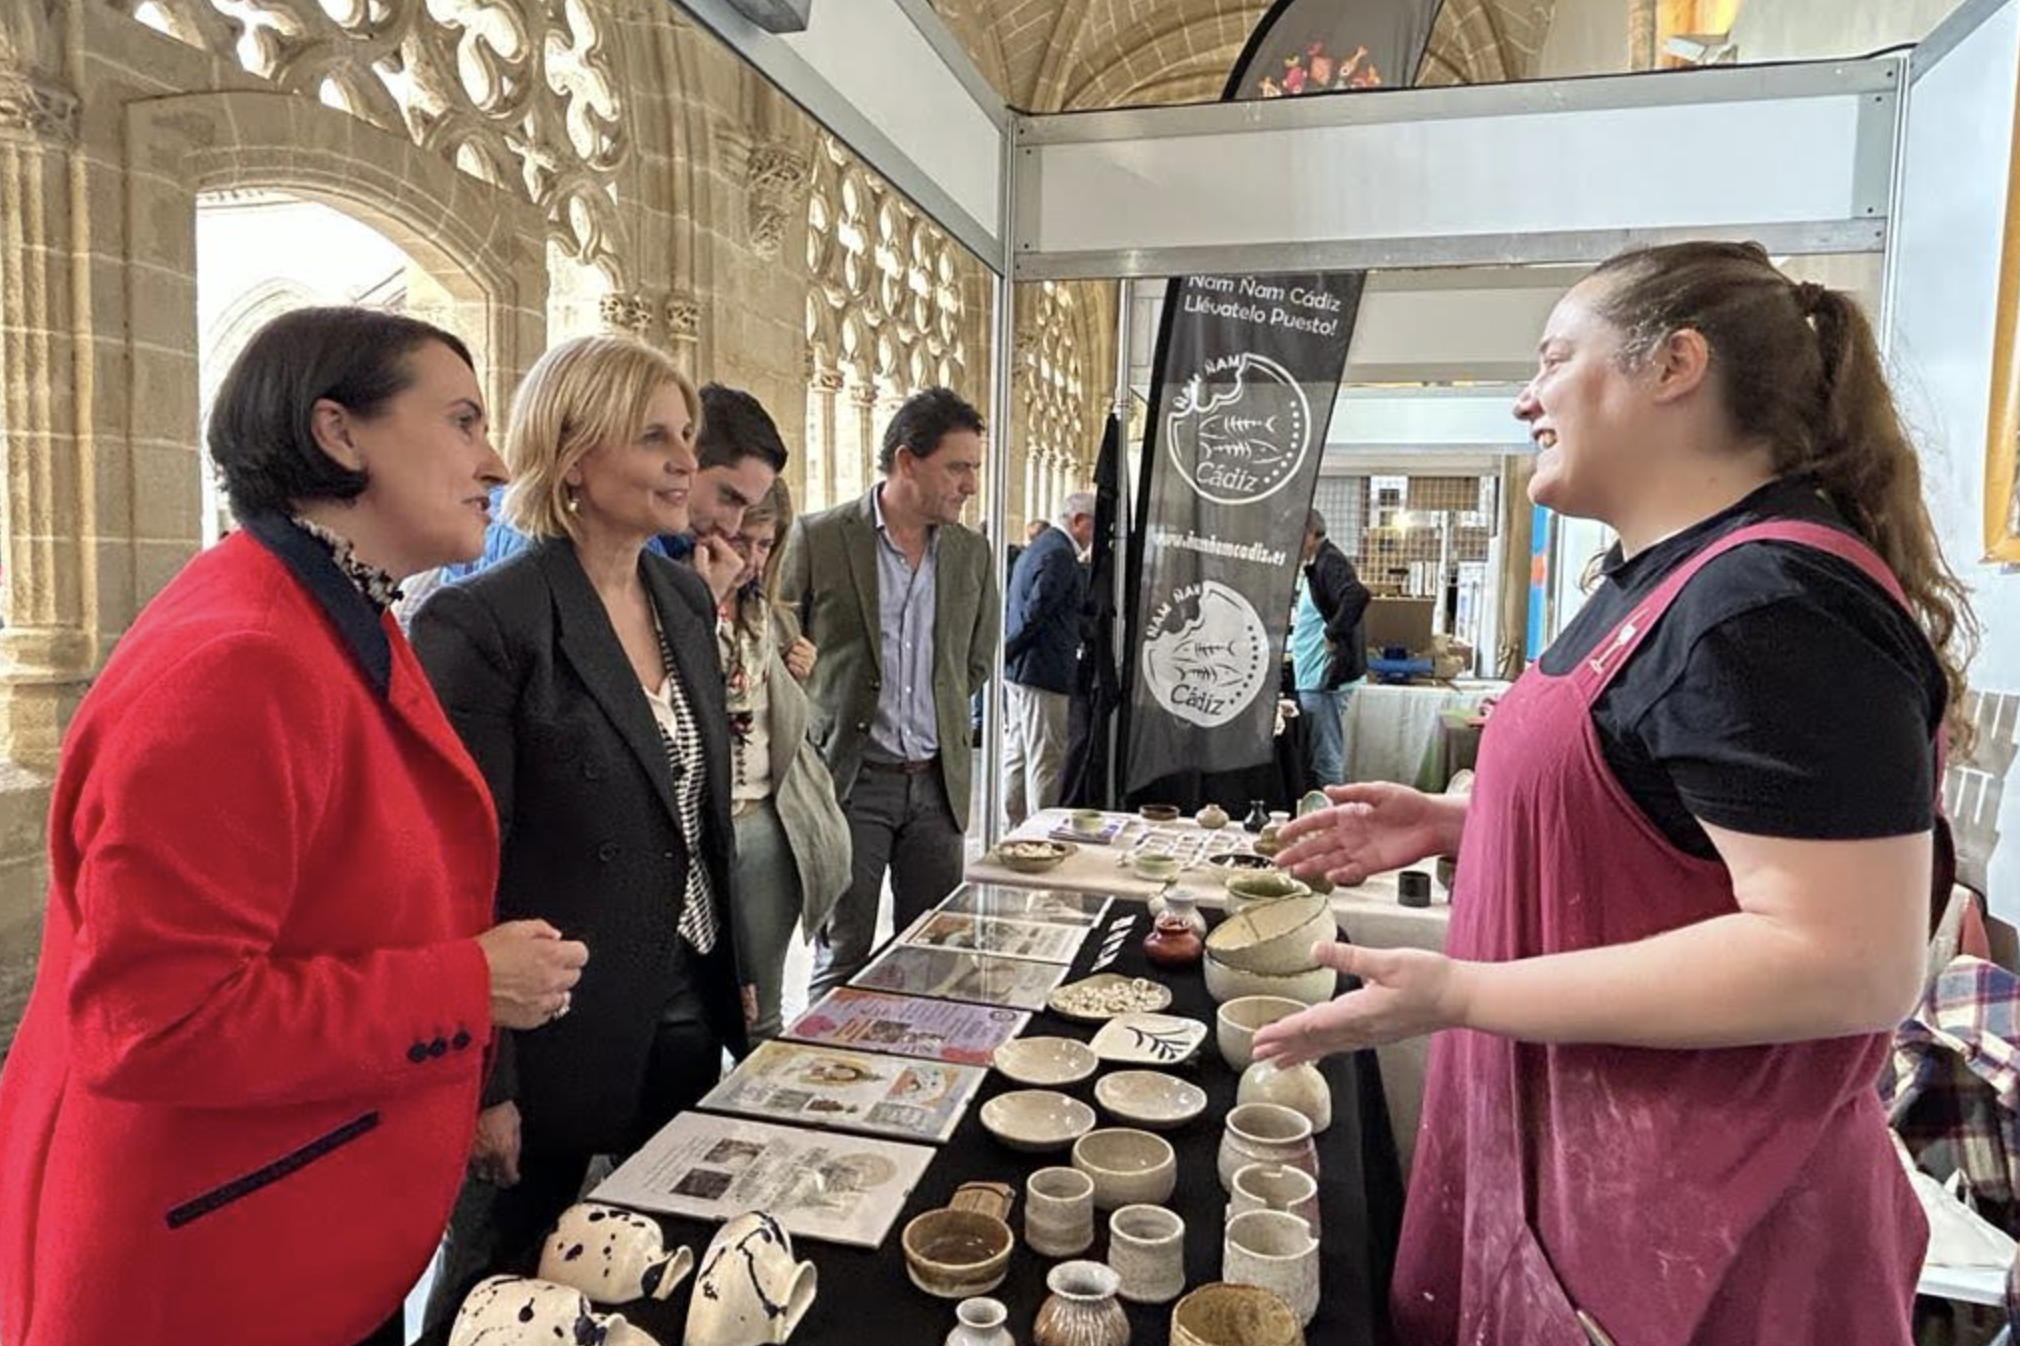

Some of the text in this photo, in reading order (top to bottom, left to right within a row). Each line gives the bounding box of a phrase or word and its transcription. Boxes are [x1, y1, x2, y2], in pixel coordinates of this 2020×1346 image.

[1238, 276, 1285, 300] Ñam
[1290, 287, 1342, 312] Cádiz
[1184, 294, 1338, 336] Llévatelo Puesto!
[1197, 461, 1258, 493] Cádiz
[1170, 684, 1225, 716] Cádiz
